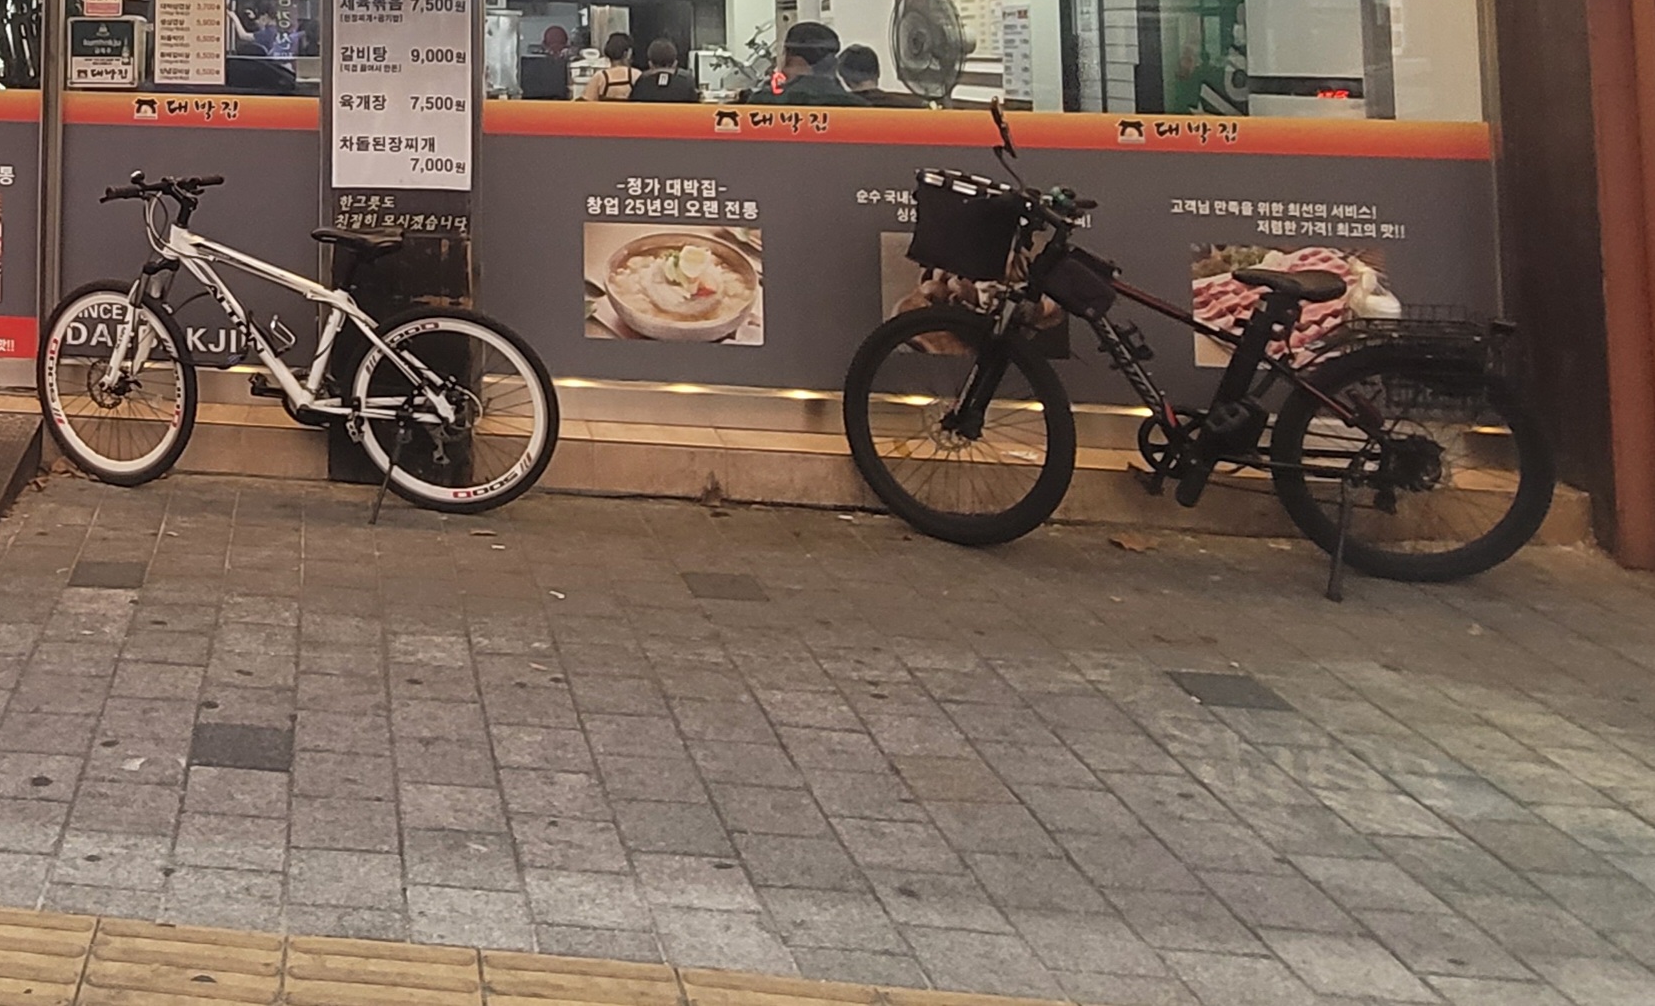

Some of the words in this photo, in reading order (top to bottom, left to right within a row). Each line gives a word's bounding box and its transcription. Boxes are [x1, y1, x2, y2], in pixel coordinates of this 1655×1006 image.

[340, 46, 388, 63] 갈비탕
[411, 48, 466, 64] 9,000원
[165, 97, 239, 120] 대박집
[339, 94, 387, 111] 육개장
[410, 96, 466, 112] 7,500원
[749, 111, 829, 133] 대박집
[1153, 120, 1239, 143] 대박집
[339, 136, 436, 153] 차돌된장찌개
[410, 158, 466, 174] 7,000원
[617, 177, 660, 196] -정가
[666, 178, 727, 197] 대박집-
[856, 189, 881, 204] 순수
[586, 196, 619, 215] 창업
[624, 198, 679, 217] 25년의
[685, 199, 719, 218] 오랜
[724, 200, 759, 219] 전통
[1170, 199, 1210, 215] 고객님
[1214, 200, 1253, 216] 만족을
[1257, 201, 1284, 217] 위한
[1288, 202, 1327, 218] 최선의
[1331, 203, 1377, 220] 서비스!
[335, 212, 377, 229] 친절히
[1257, 220, 1296, 236] 저렴한
[1300, 220, 1332, 237] 가격!
[1336, 222, 1376, 238] 최고의
[1380, 223, 1405, 239] 맛!!
[72, 303, 125, 320] INCE
